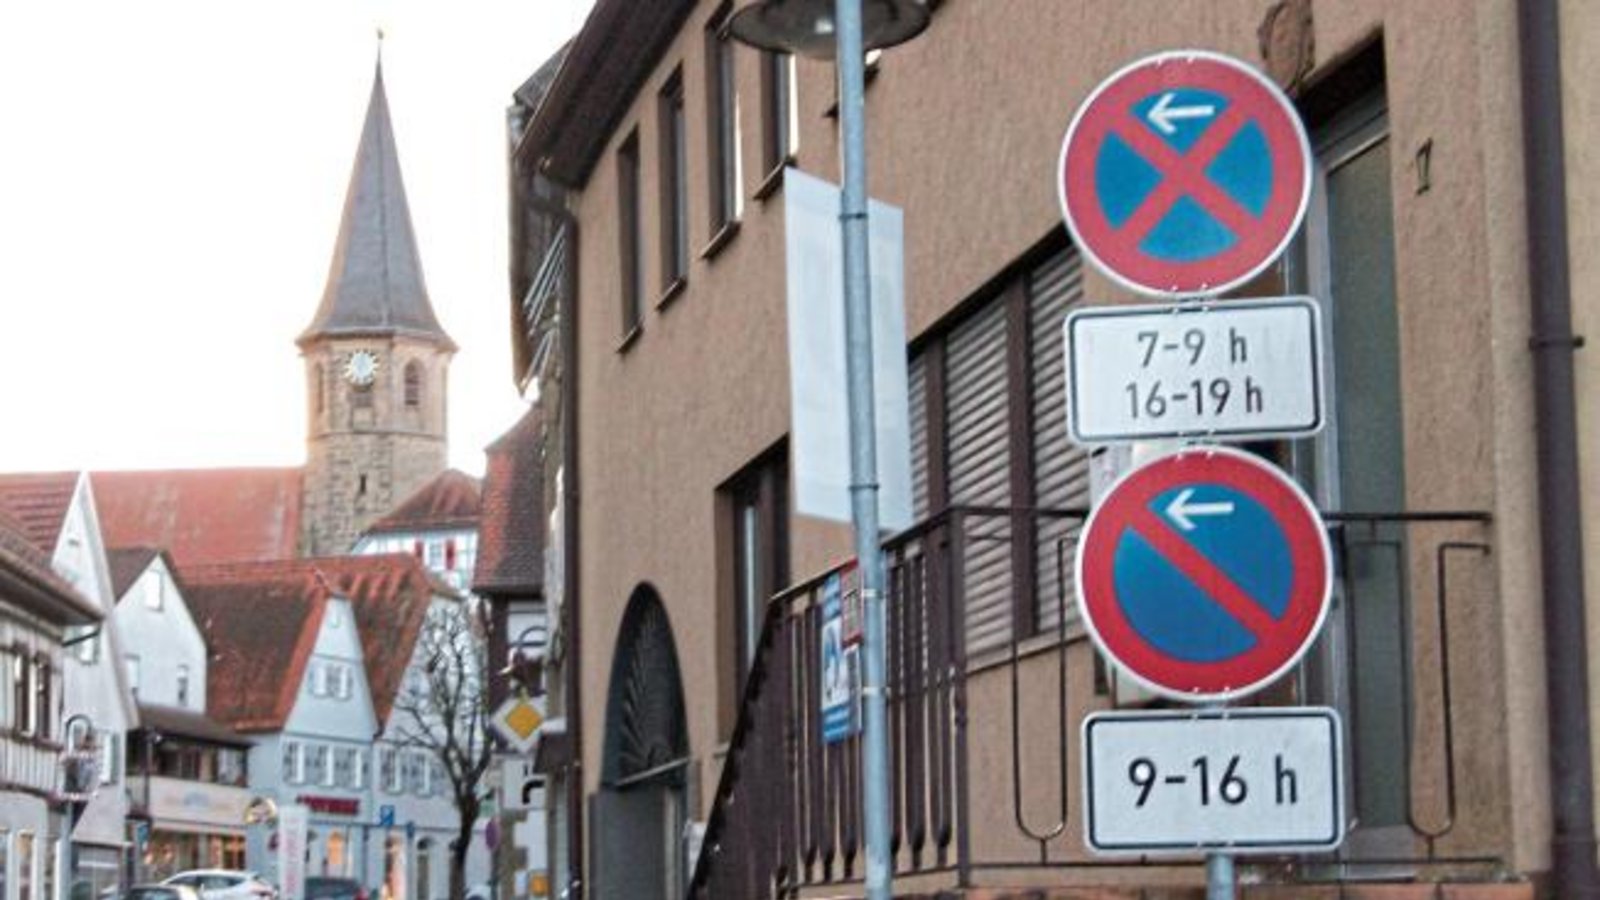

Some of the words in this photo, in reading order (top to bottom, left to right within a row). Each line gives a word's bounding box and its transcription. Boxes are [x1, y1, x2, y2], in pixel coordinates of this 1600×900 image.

[1137, 328, 1206, 368] 7-9
[1229, 327, 1248, 364] h
[1125, 377, 1231, 419] 16-19
[1245, 375, 1263, 413] h
[1128, 755, 1248, 808] 9-16
[1275, 753, 1297, 805] h
